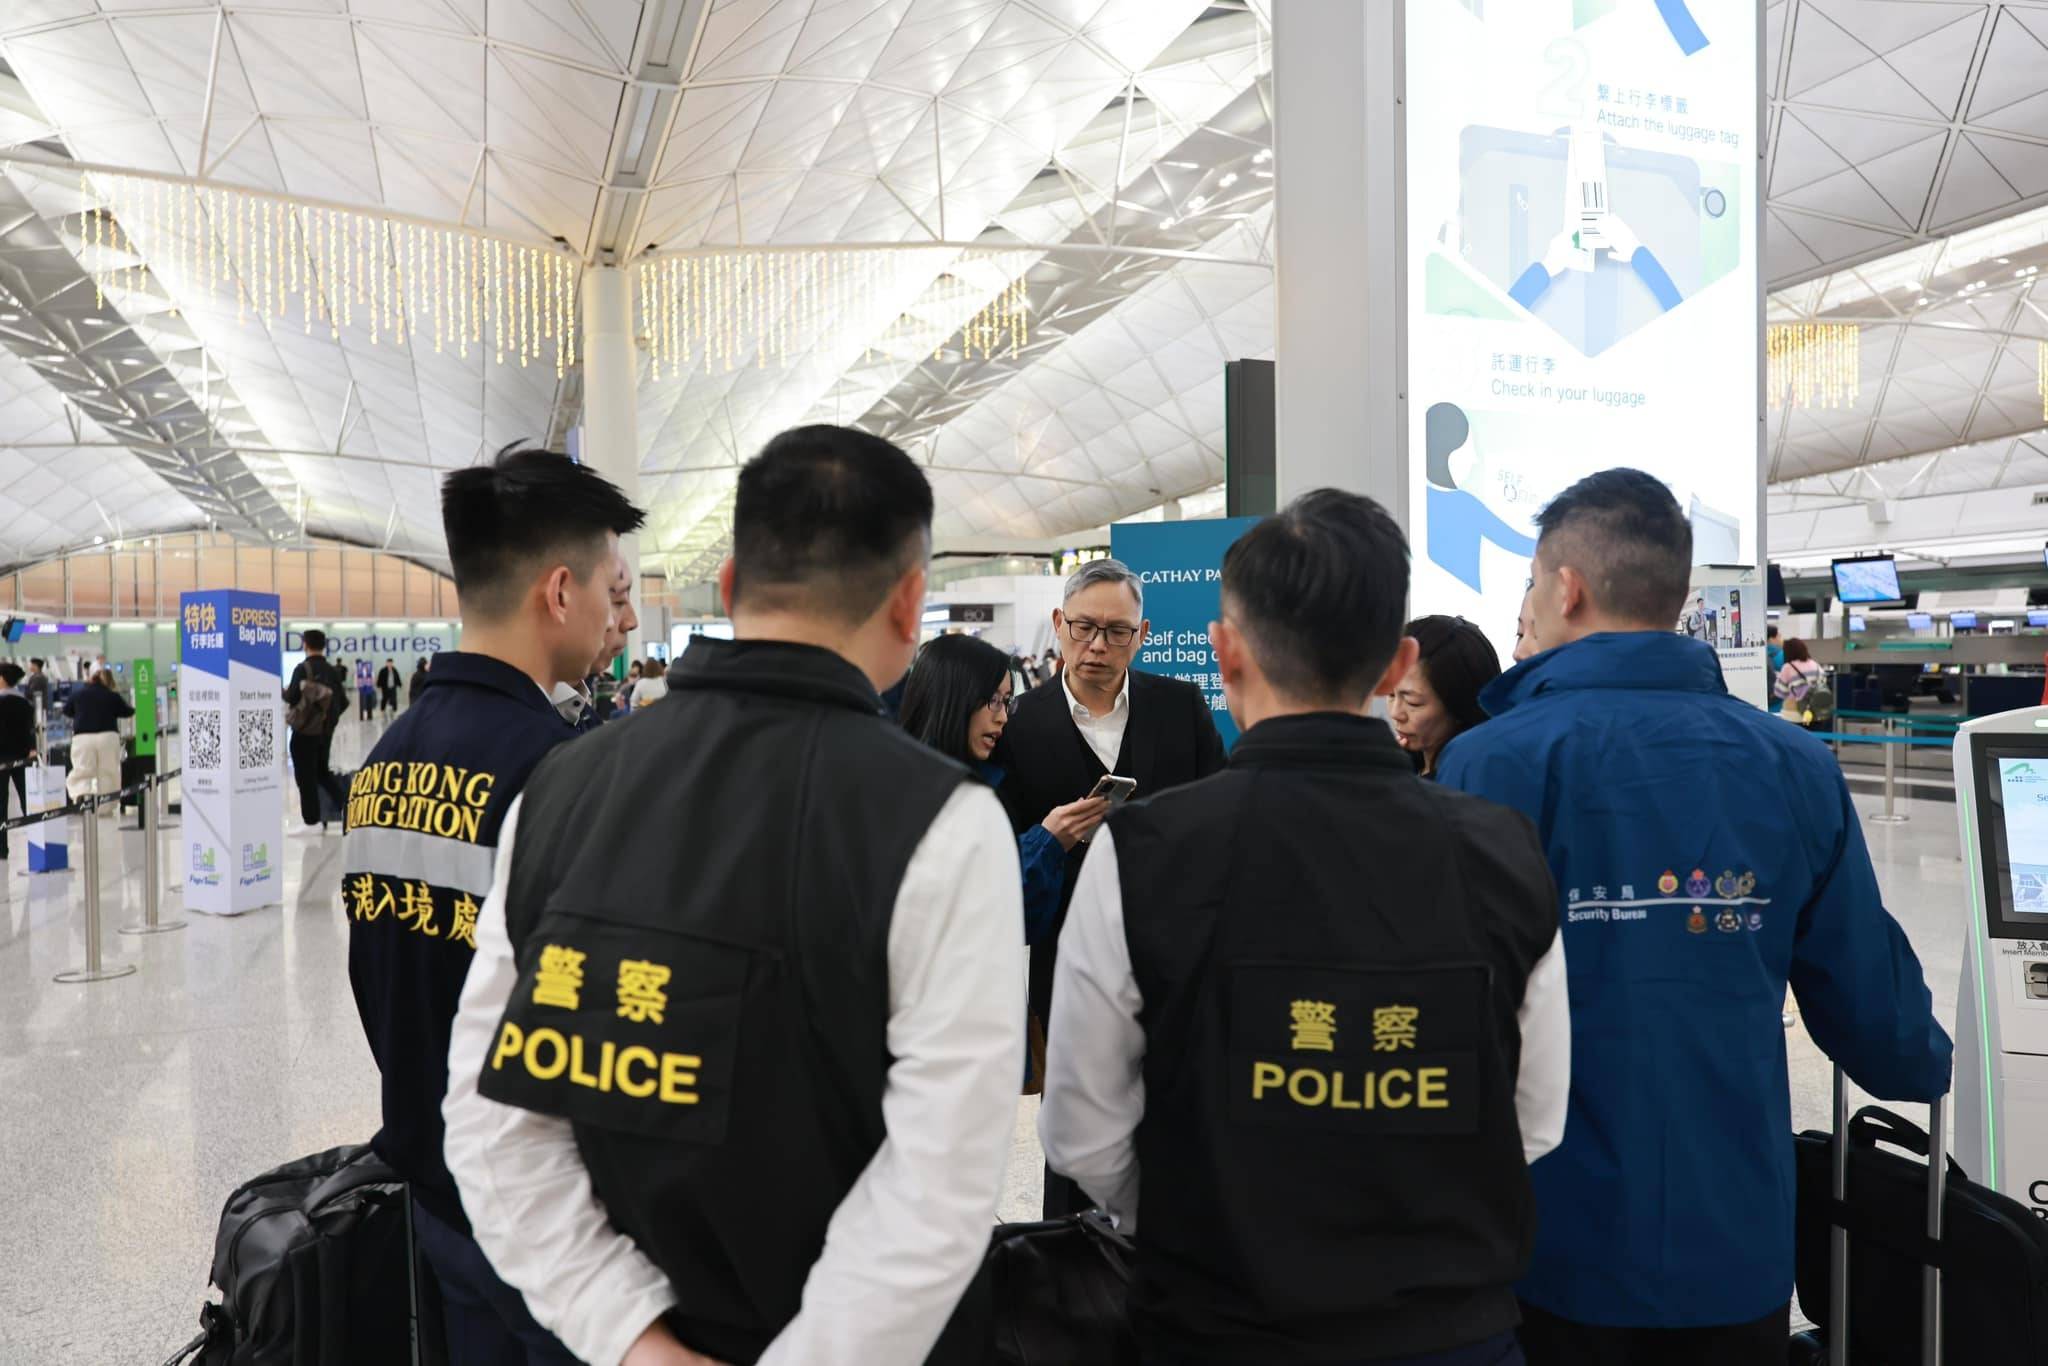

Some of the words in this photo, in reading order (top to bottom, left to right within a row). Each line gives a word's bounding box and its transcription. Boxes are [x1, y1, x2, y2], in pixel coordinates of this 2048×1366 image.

[1596, 109, 1640, 129] Attach
[1644, 115, 1664, 133] the
[1668, 119, 1716, 144] luggage
[1720, 127, 1739, 148] tag
[1491, 379, 1535, 398] Check
[1540, 381, 1552, 397] in
[1557, 386, 1588, 403] your
[1593, 386, 1646, 408] luggage
[1140, 569, 1202, 584] CATHAY
[185, 602, 216, 632] 特快
[232, 608, 276, 627] EXPRESS
[239, 626, 255, 645] Bag
[257, 628, 276, 647] Drop
[285, 631, 441, 656] Dpartures
[1143, 631, 1173, 646] Self
[1142, 648, 1171, 663] and
[1176, 648, 1207, 665] bag
[240, 690, 256, 701] Start
[258, 690, 272, 700] here
[350, 762, 403, 800] HONG
[405, 761, 495, 808] KONG
[1568, 908, 1610, 922] Security
[1612, 908, 1647, 921] Bureau
[533, 944, 671, 1025] 警察
[1289, 999, 1419, 1052] 警察
[492, 1022, 701, 1104] POLICE
[1253, 1060, 1449, 1110] POLICE
